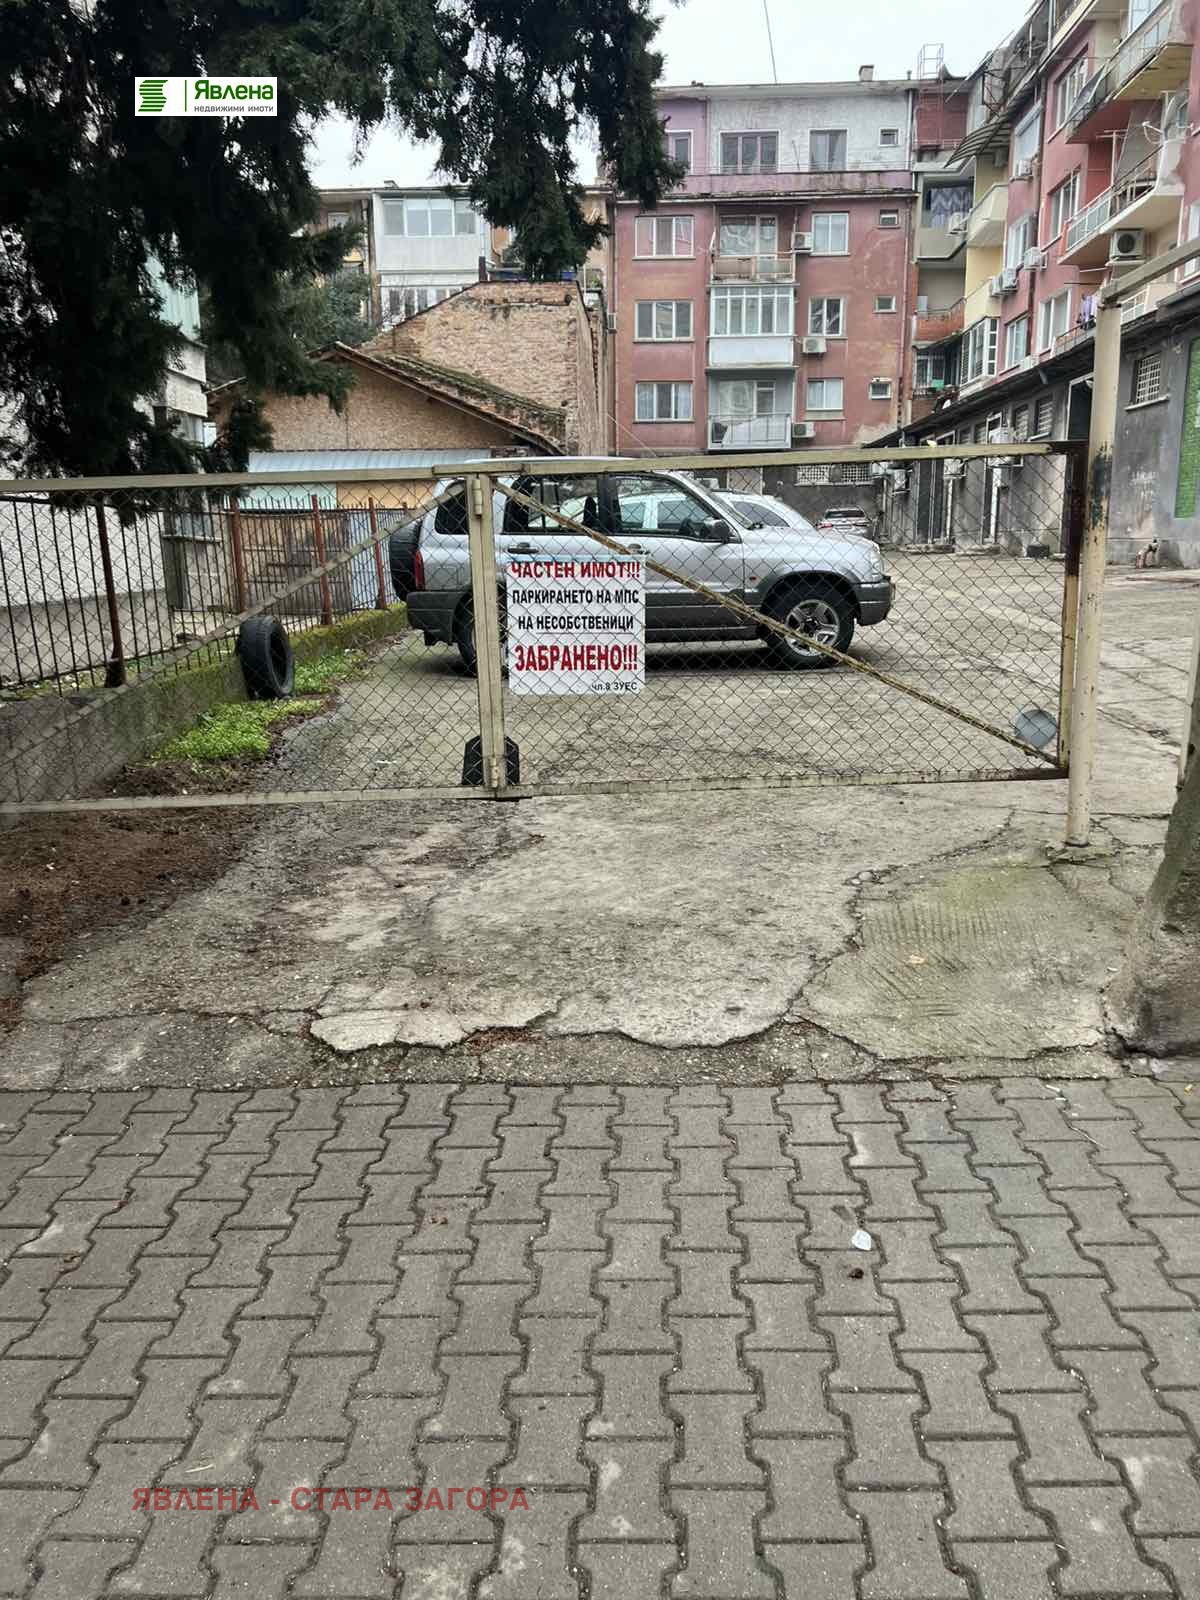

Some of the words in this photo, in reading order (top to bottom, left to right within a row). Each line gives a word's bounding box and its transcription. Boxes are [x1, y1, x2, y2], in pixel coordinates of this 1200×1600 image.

[511, 561, 575, 578] ЧАСТЕН
[580, 561, 640, 578] ИМОТ!!!
[512, 589, 593, 604] ПАРКИРАНЕТО
[596, 589, 612, 604] НА
[615, 589, 639, 604] МПС
[518, 615, 534, 630] НА
[536, 615, 634, 632] НЕСОБСТВЕНИЦИ
[514, 644, 638, 671] ЗАБРАНЕНО!!!
